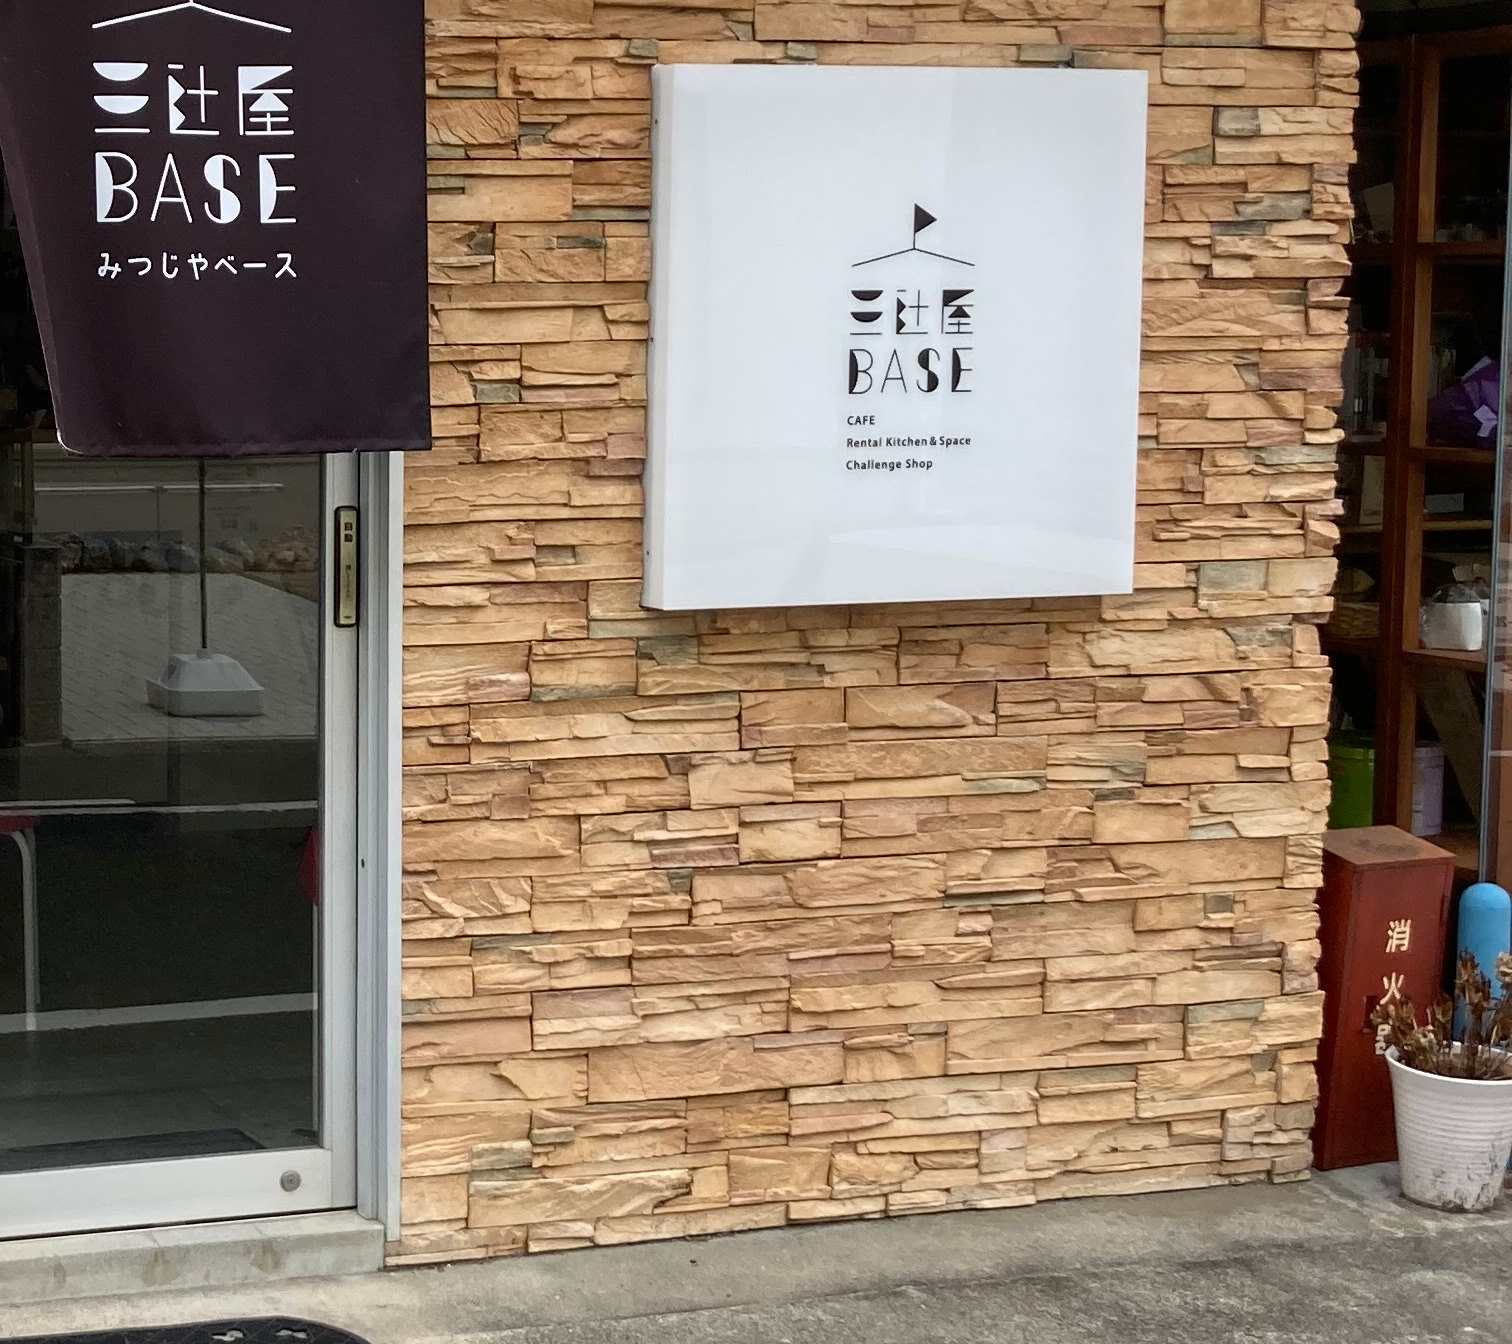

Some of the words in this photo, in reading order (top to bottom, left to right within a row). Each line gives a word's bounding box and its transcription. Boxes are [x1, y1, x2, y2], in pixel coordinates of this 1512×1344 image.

[92, 62, 294, 136] 三辻屋
[94, 150, 296, 224] BASE
[97, 251, 296, 279] みつじやベース
[849, 289, 974, 335] 三辻屋
[848, 347, 973, 394] BASE
[847, 415, 876, 426] CAFE
[846, 437, 882, 448] Rental
[846, 458, 902, 471] Challenge
[905, 458, 933, 470] Shop
